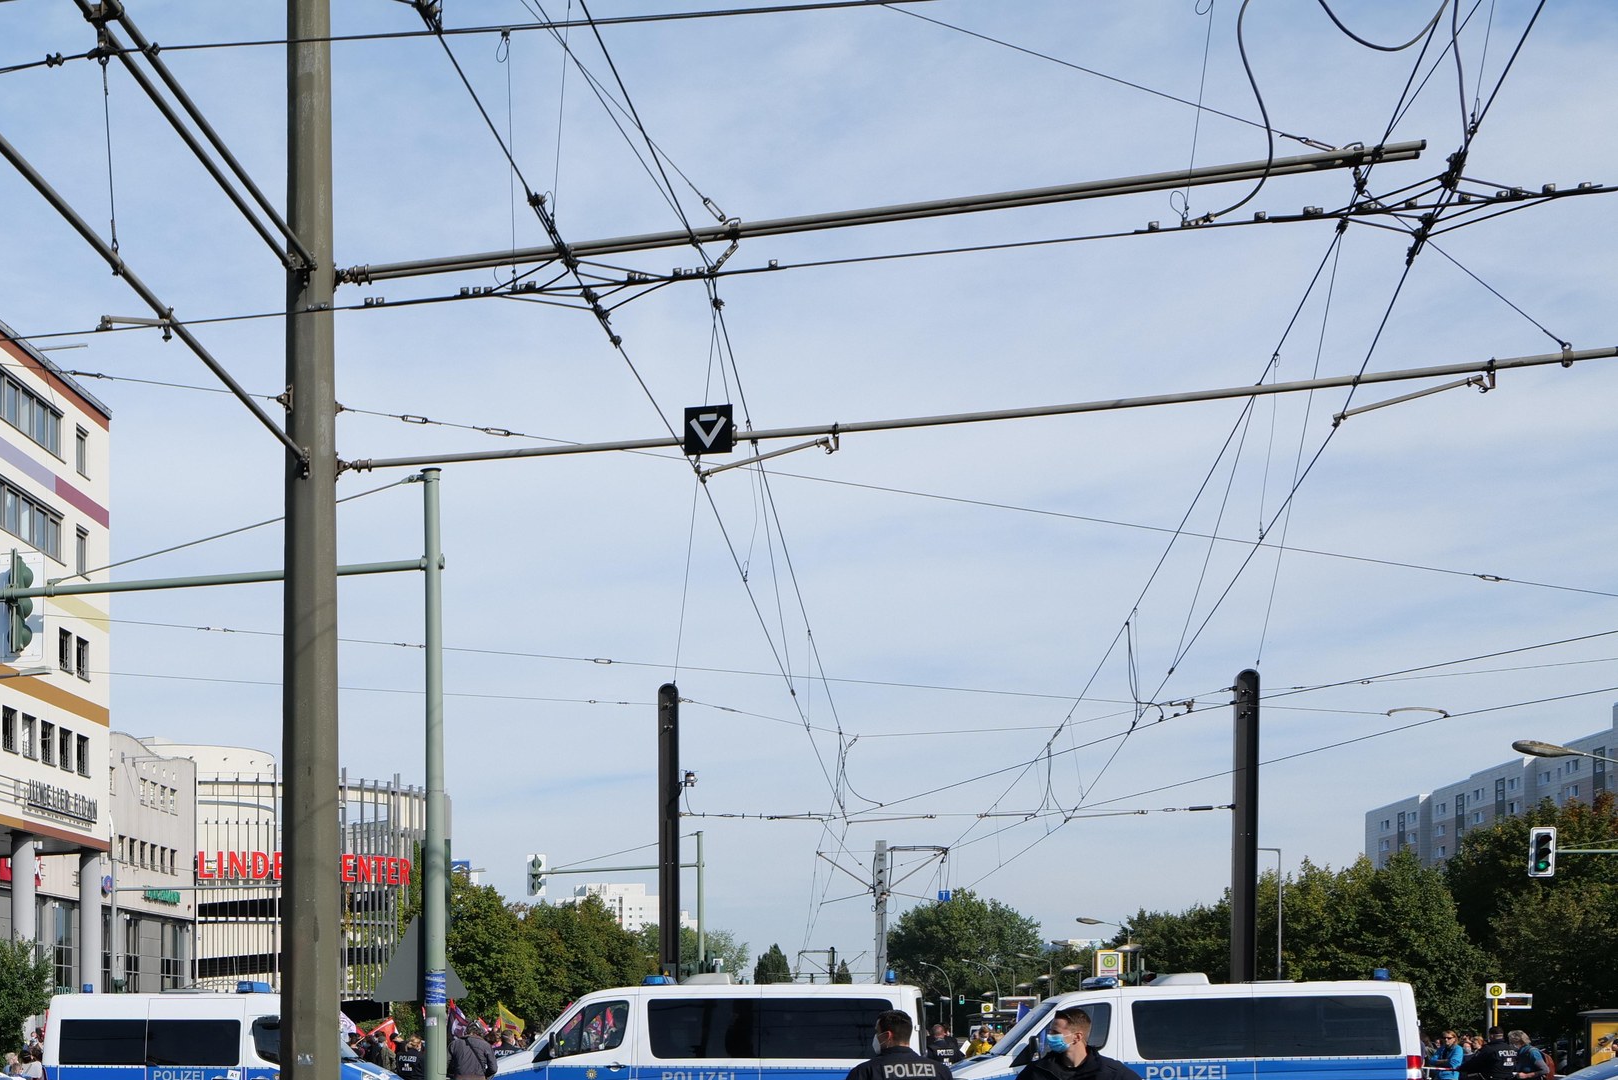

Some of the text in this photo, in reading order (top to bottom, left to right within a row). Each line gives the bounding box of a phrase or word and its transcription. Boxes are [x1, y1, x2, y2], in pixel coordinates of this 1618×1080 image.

[197, 850, 282, 881] LINDE
[340, 853, 412, 886] ENTER
[884, 1063, 936, 1079] POLIZEI
[1145, 1065, 1227, 1080] POLIZEI
